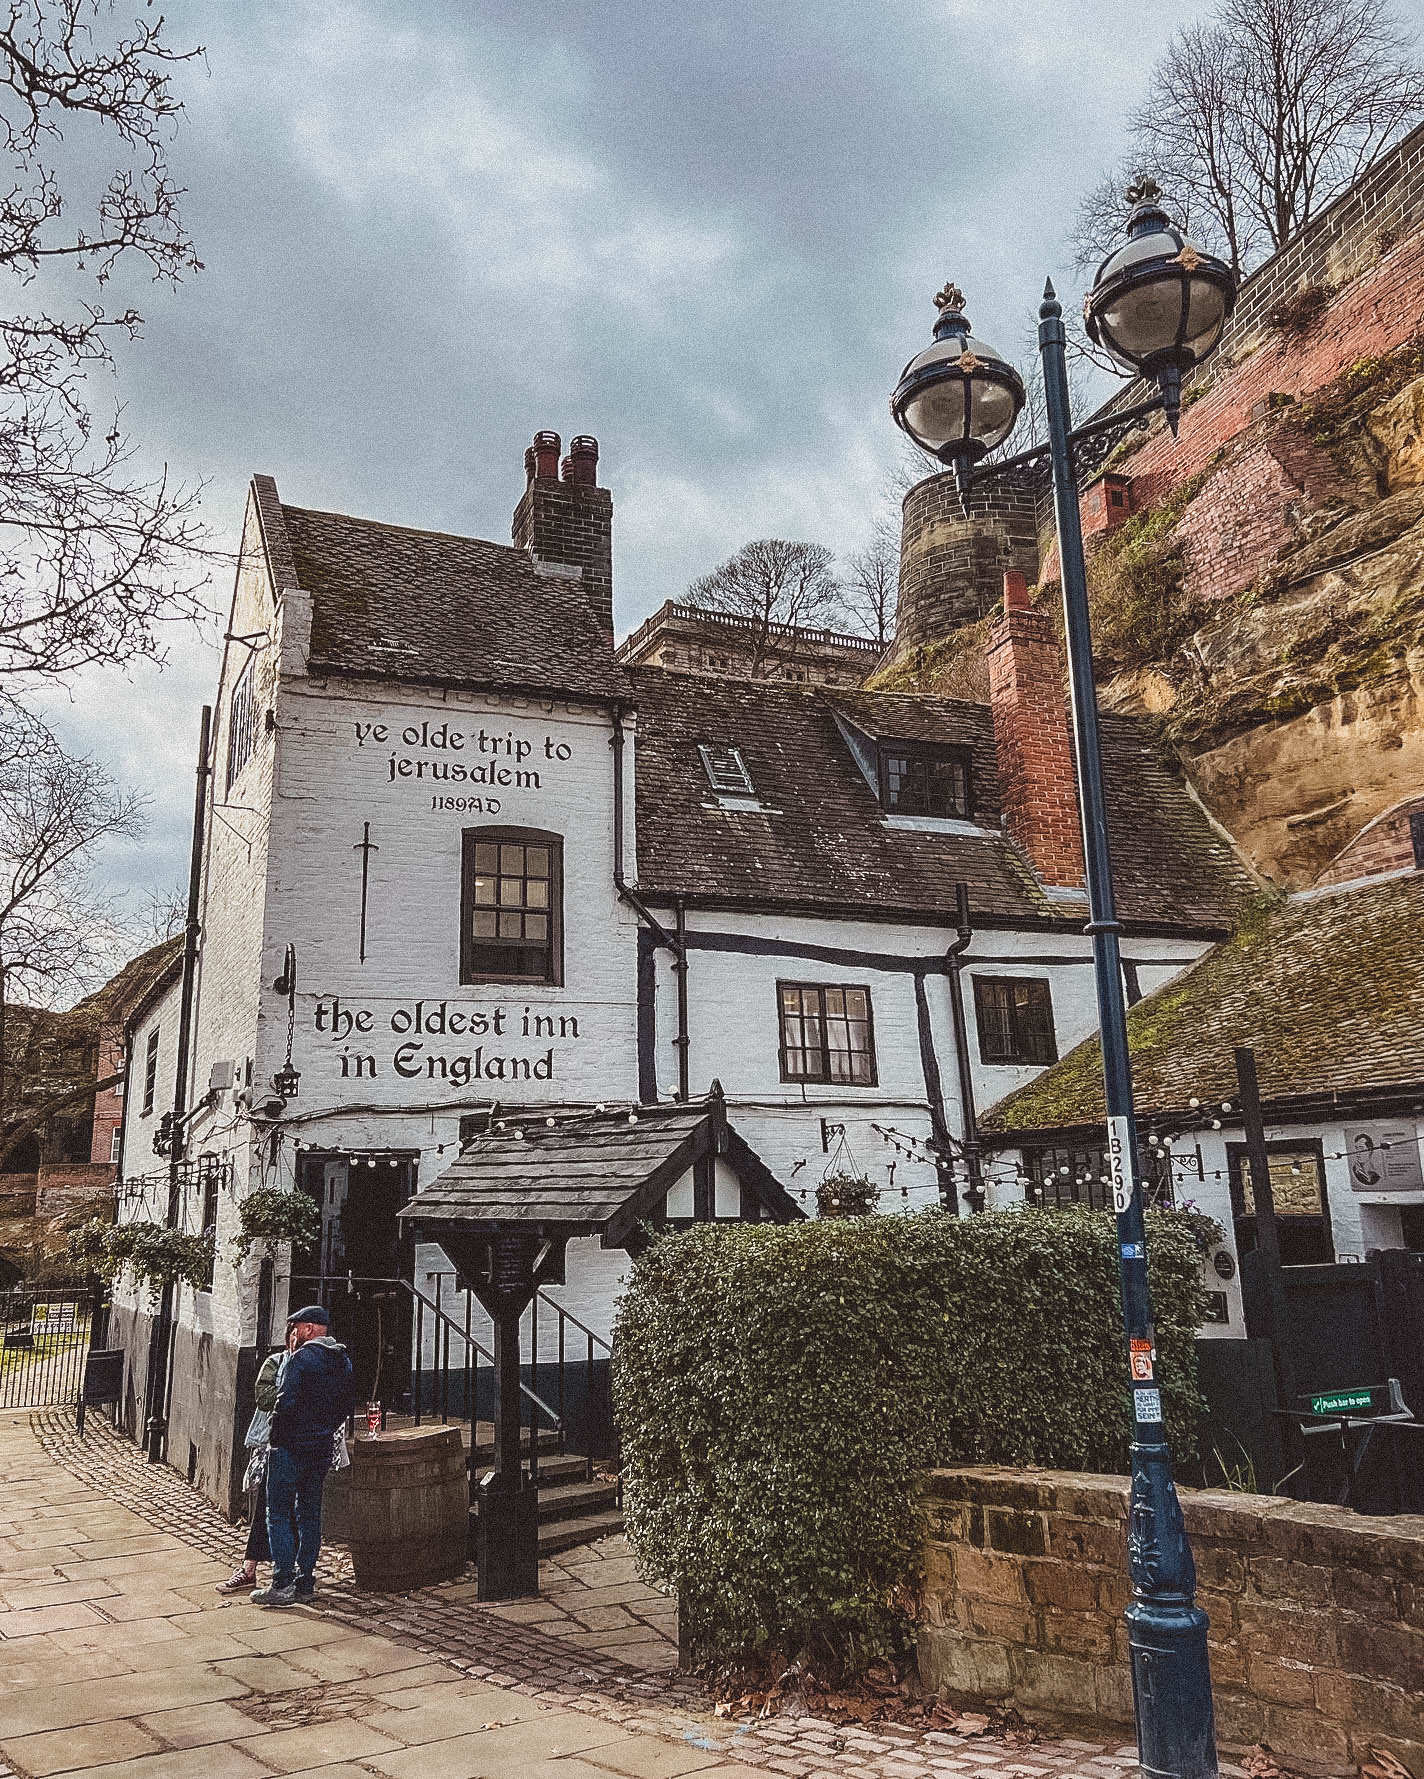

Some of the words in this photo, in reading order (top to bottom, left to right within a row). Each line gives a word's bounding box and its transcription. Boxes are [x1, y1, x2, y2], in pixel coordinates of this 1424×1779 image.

[352, 721, 388, 748] ye
[402, 721, 465, 751] olde
[477, 728, 532, 764] trip
[543, 736, 572, 761] to
[386, 751, 543, 790] jerusalem
[431, 795, 502, 815] 1189AD
[313, 999, 374, 1042] the
[390, 1000, 507, 1037] oldest
[521, 1006, 581, 1039] inn
[339, 1045, 378, 1079] in
[393, 1041, 555, 1089] England
[1323, 1399, 1338, 1410] Push
[1338, 1398, 1348, 1407] bar
[1348, 1397, 1356, 1405] to
[1356, 1396, 1371, 1406] open
